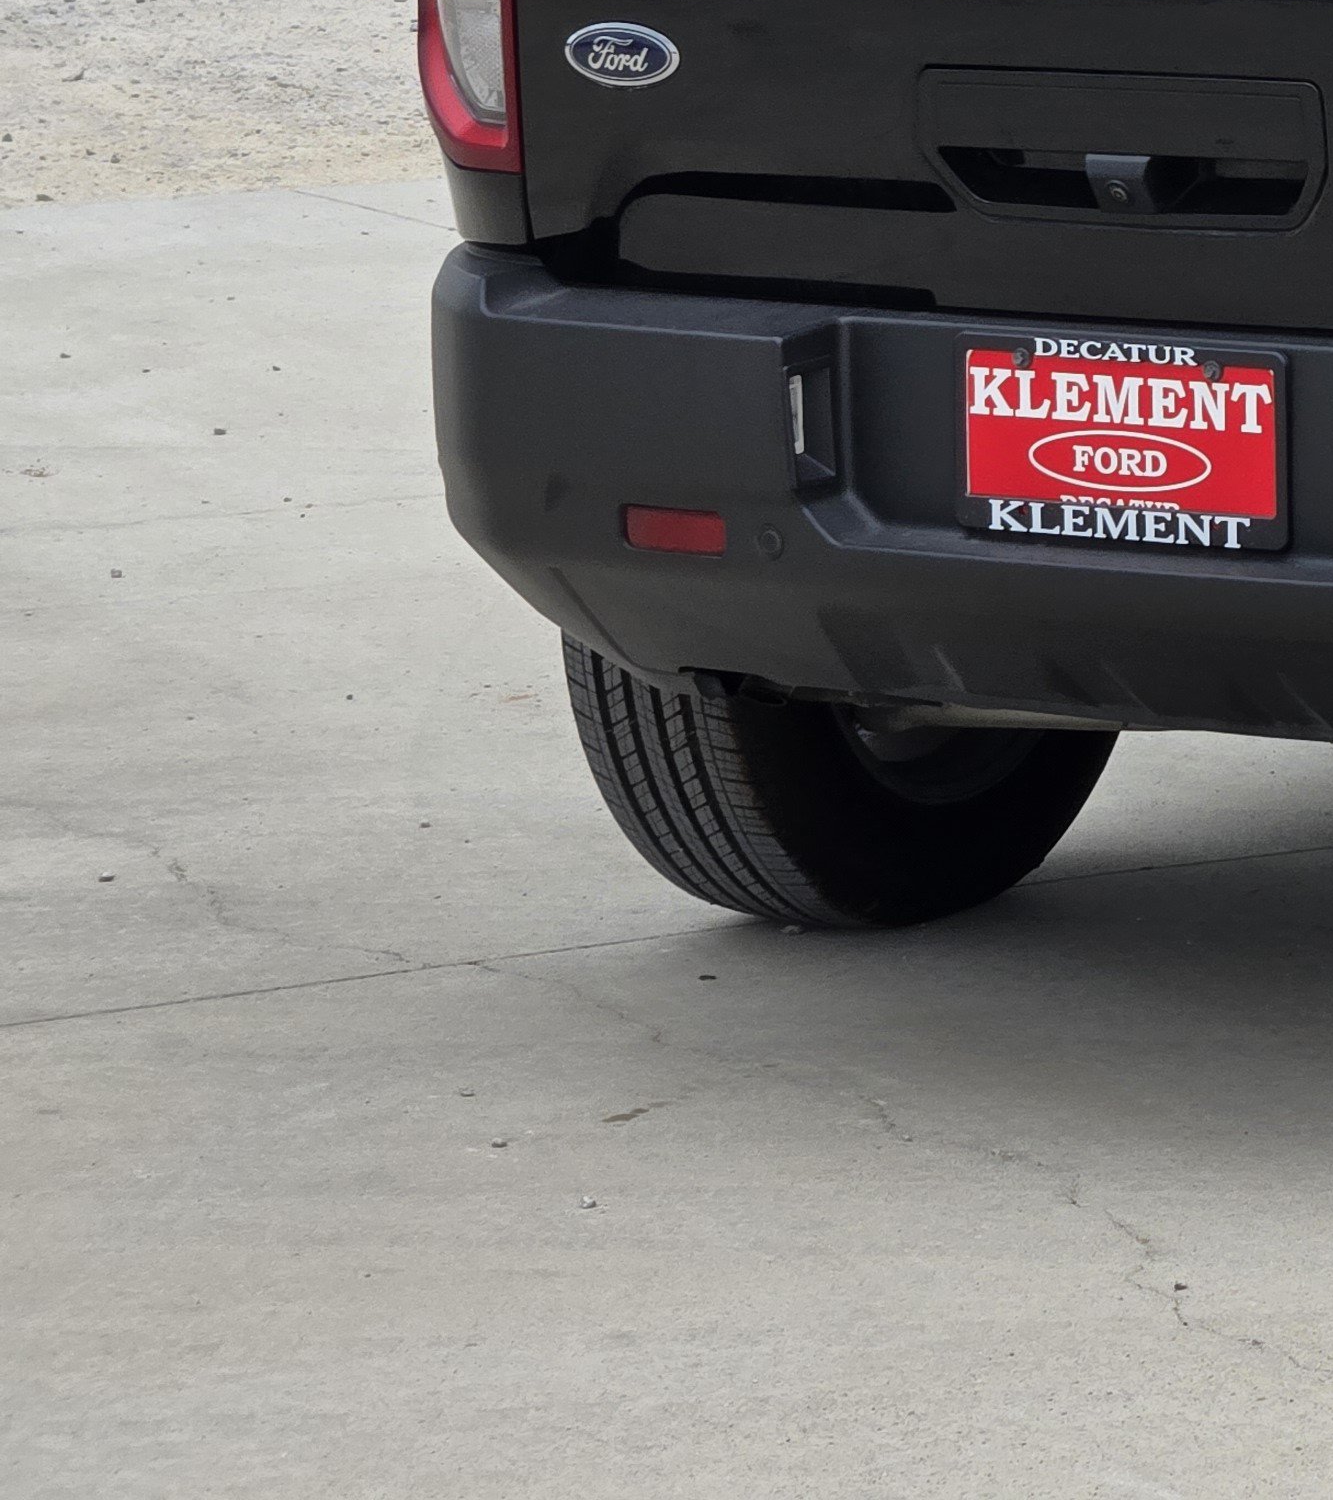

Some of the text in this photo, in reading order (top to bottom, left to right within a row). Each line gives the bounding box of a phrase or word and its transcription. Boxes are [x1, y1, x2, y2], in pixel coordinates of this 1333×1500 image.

[587, 35, 650, 75] Ford
[1034, 338, 1198, 366] DECATUR
[969, 366, 1272, 433] KLEMENT
[1072, 445, 1168, 477] FORD
[988, 499, 1251, 548] KLEMENT
